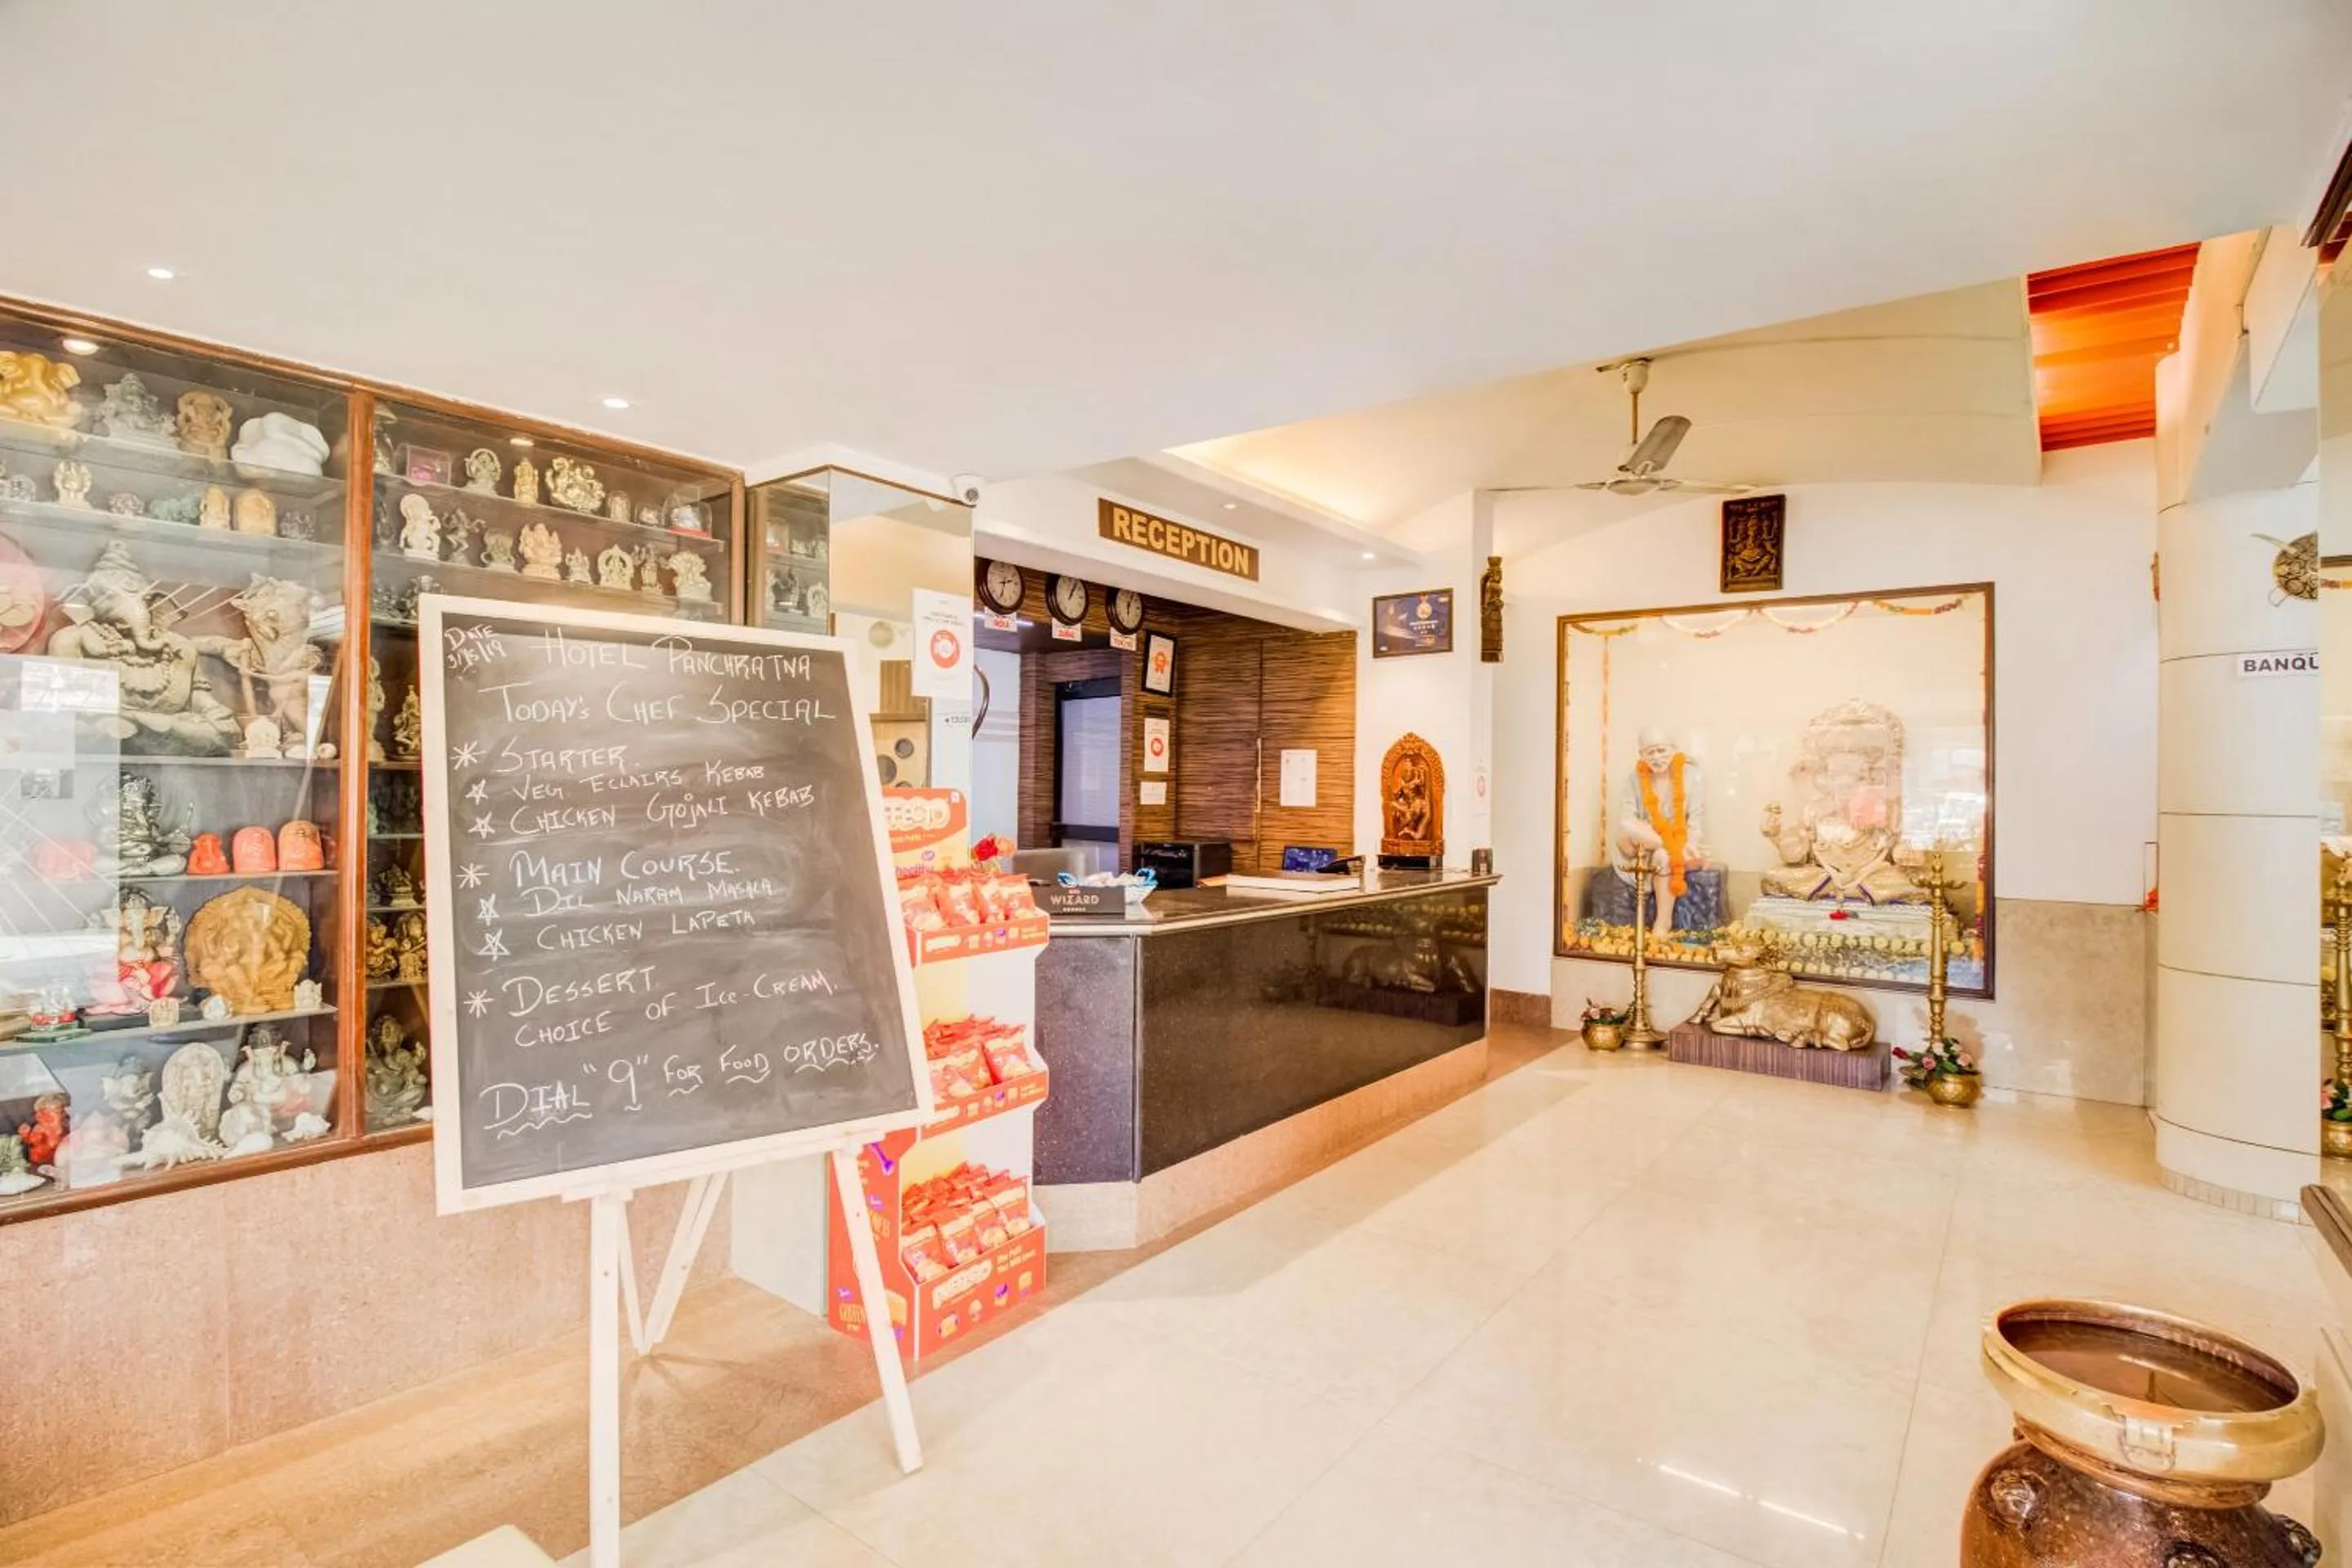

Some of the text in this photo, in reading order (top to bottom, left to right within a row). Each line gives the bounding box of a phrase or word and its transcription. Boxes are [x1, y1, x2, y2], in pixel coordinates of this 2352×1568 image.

[1112, 506, 1250, 576] RECEPTION
[528, 626, 810, 681] HOTEL PANCHRATNA
[607, 681, 683, 724] CHEF
[697, 684, 836, 725] SPECIAL
[513, 760, 766, 802] VEG ECLAIRS KEBAB
[510, 804, 616, 835] CHICKEN
[747, 785, 815, 816] KEBAB
[509, 850, 603, 887] MAIN
[521, 886, 594, 916] DIL
[1050, 895, 1099, 906] WIZARD
[537, 924, 644, 950] CHICKEN
[514, 1010, 613, 1047] CHOICE
[645, 992, 678, 1020] OF
[479, 1080, 591, 1130] DIAL
[664, 1054, 703, 1084] FOR
[719, 1044, 769, 1073] FOOD
